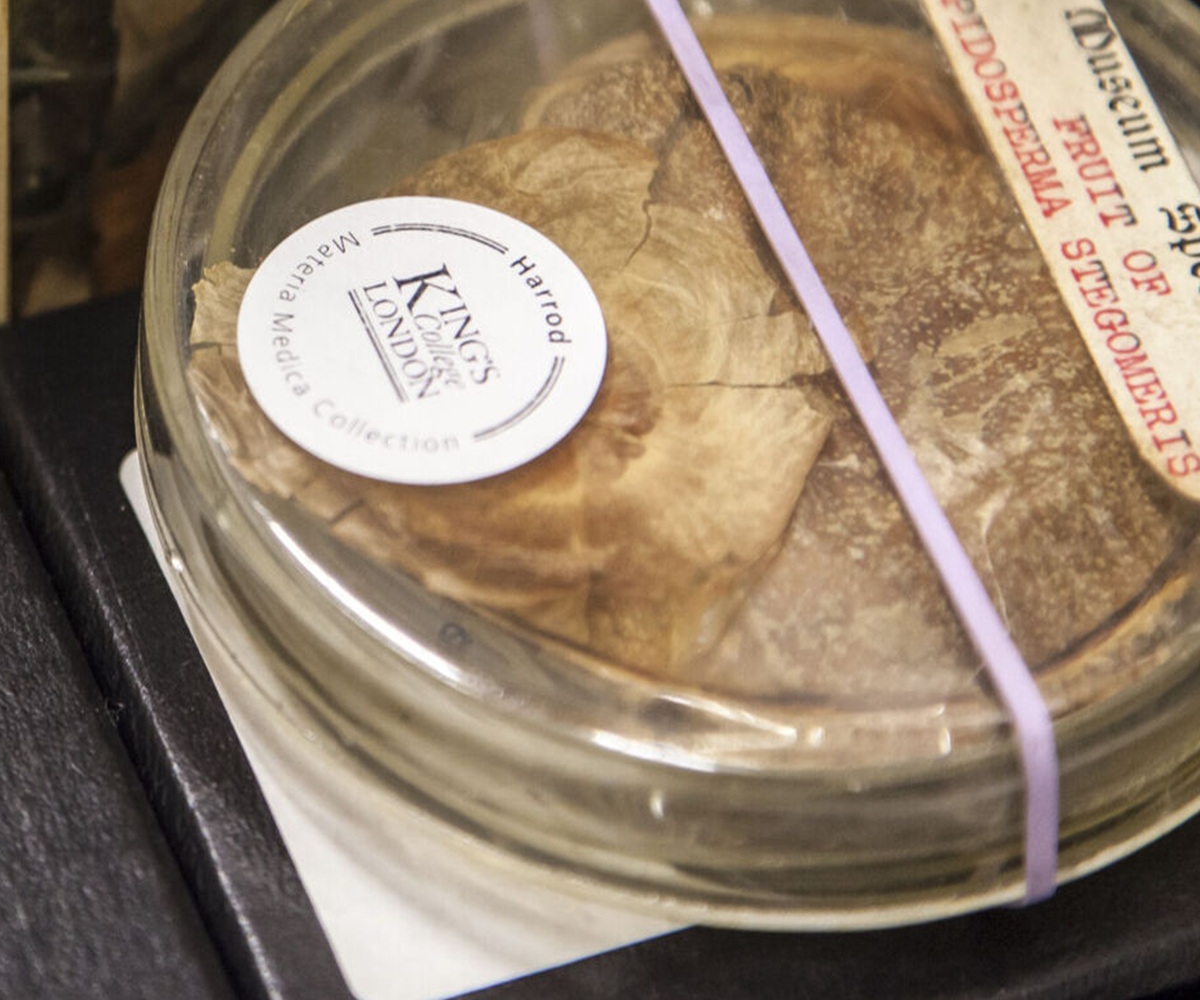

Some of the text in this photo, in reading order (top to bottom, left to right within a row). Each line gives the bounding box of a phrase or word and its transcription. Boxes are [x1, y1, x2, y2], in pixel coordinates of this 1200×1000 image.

[1066, 6, 1170, 174] Museum
[1053, 114, 1173, 297] FRUIT OF
[271, 230, 460, 455] Materia Medica Collection
[362, 281, 442, 399] LONDON
[413, 313, 466, 389] College
[509, 253, 572, 346] Harrod
[1060, 237, 1200, 478] STEGOMERIS
